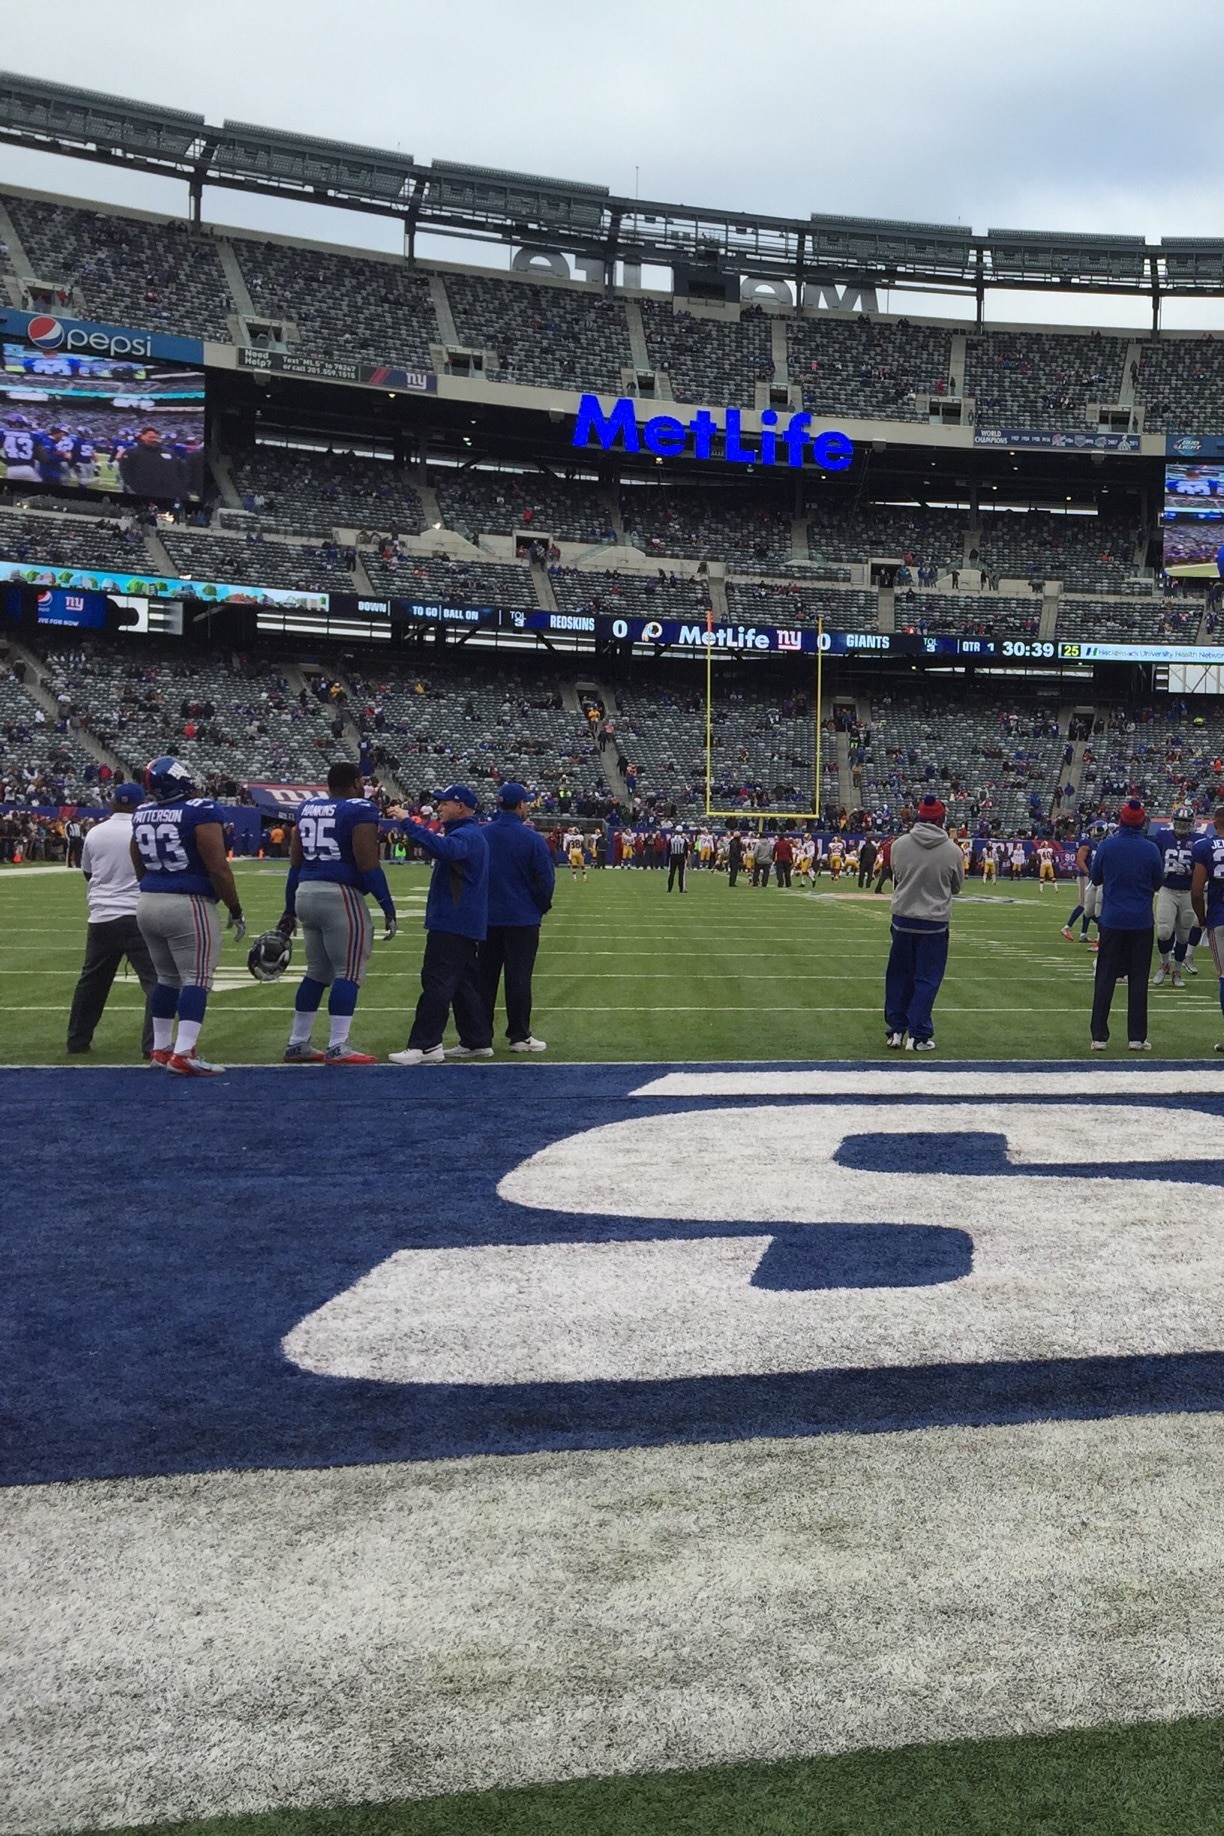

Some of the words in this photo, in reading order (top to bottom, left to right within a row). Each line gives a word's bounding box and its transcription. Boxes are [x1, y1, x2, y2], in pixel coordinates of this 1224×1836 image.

[67, 329, 151, 357] pepsi
[244, 349, 269, 359] Need
[244, 357, 272, 368] Help?
[282, 356, 299, 365] Text
[325, 361, 333, 369] to
[282, 363, 291, 371] or
[292, 364, 306, 373] call
[572, 393, 855, 472] MetLife
[981, 430, 1002, 438] WORLD
[974, 436, 1008, 445] CHAMPIONS
[358, 601, 387, 613] DOWN
[412, 605, 424, 617] TO
[425, 607, 438, 618] GO
[443, 608, 464, 620] BALL
[465, 610, 479, 621] ON
[550, 614, 595, 631] REDSKINS
[612, 620, 628, 638] 0
[678, 625, 770, 650] MetLife
[817, 633, 832, 651] 0
[846, 633, 890, 649] GIANTS
[962, 643, 981, 653] QTR
[987, 643, 995, 652] 1
[1002, 641, 1055, 658] 30:39
[1063, 644, 1080, 657] 25
[1140, 650, 1174, 659] University
[132, 809, 182, 823] PATTERSON
[301, 804, 336, 817] HANKINS
[300, 818, 342, 861] 95
[135, 824, 190, 872] 93
[1164, 848, 1192, 873] 65
